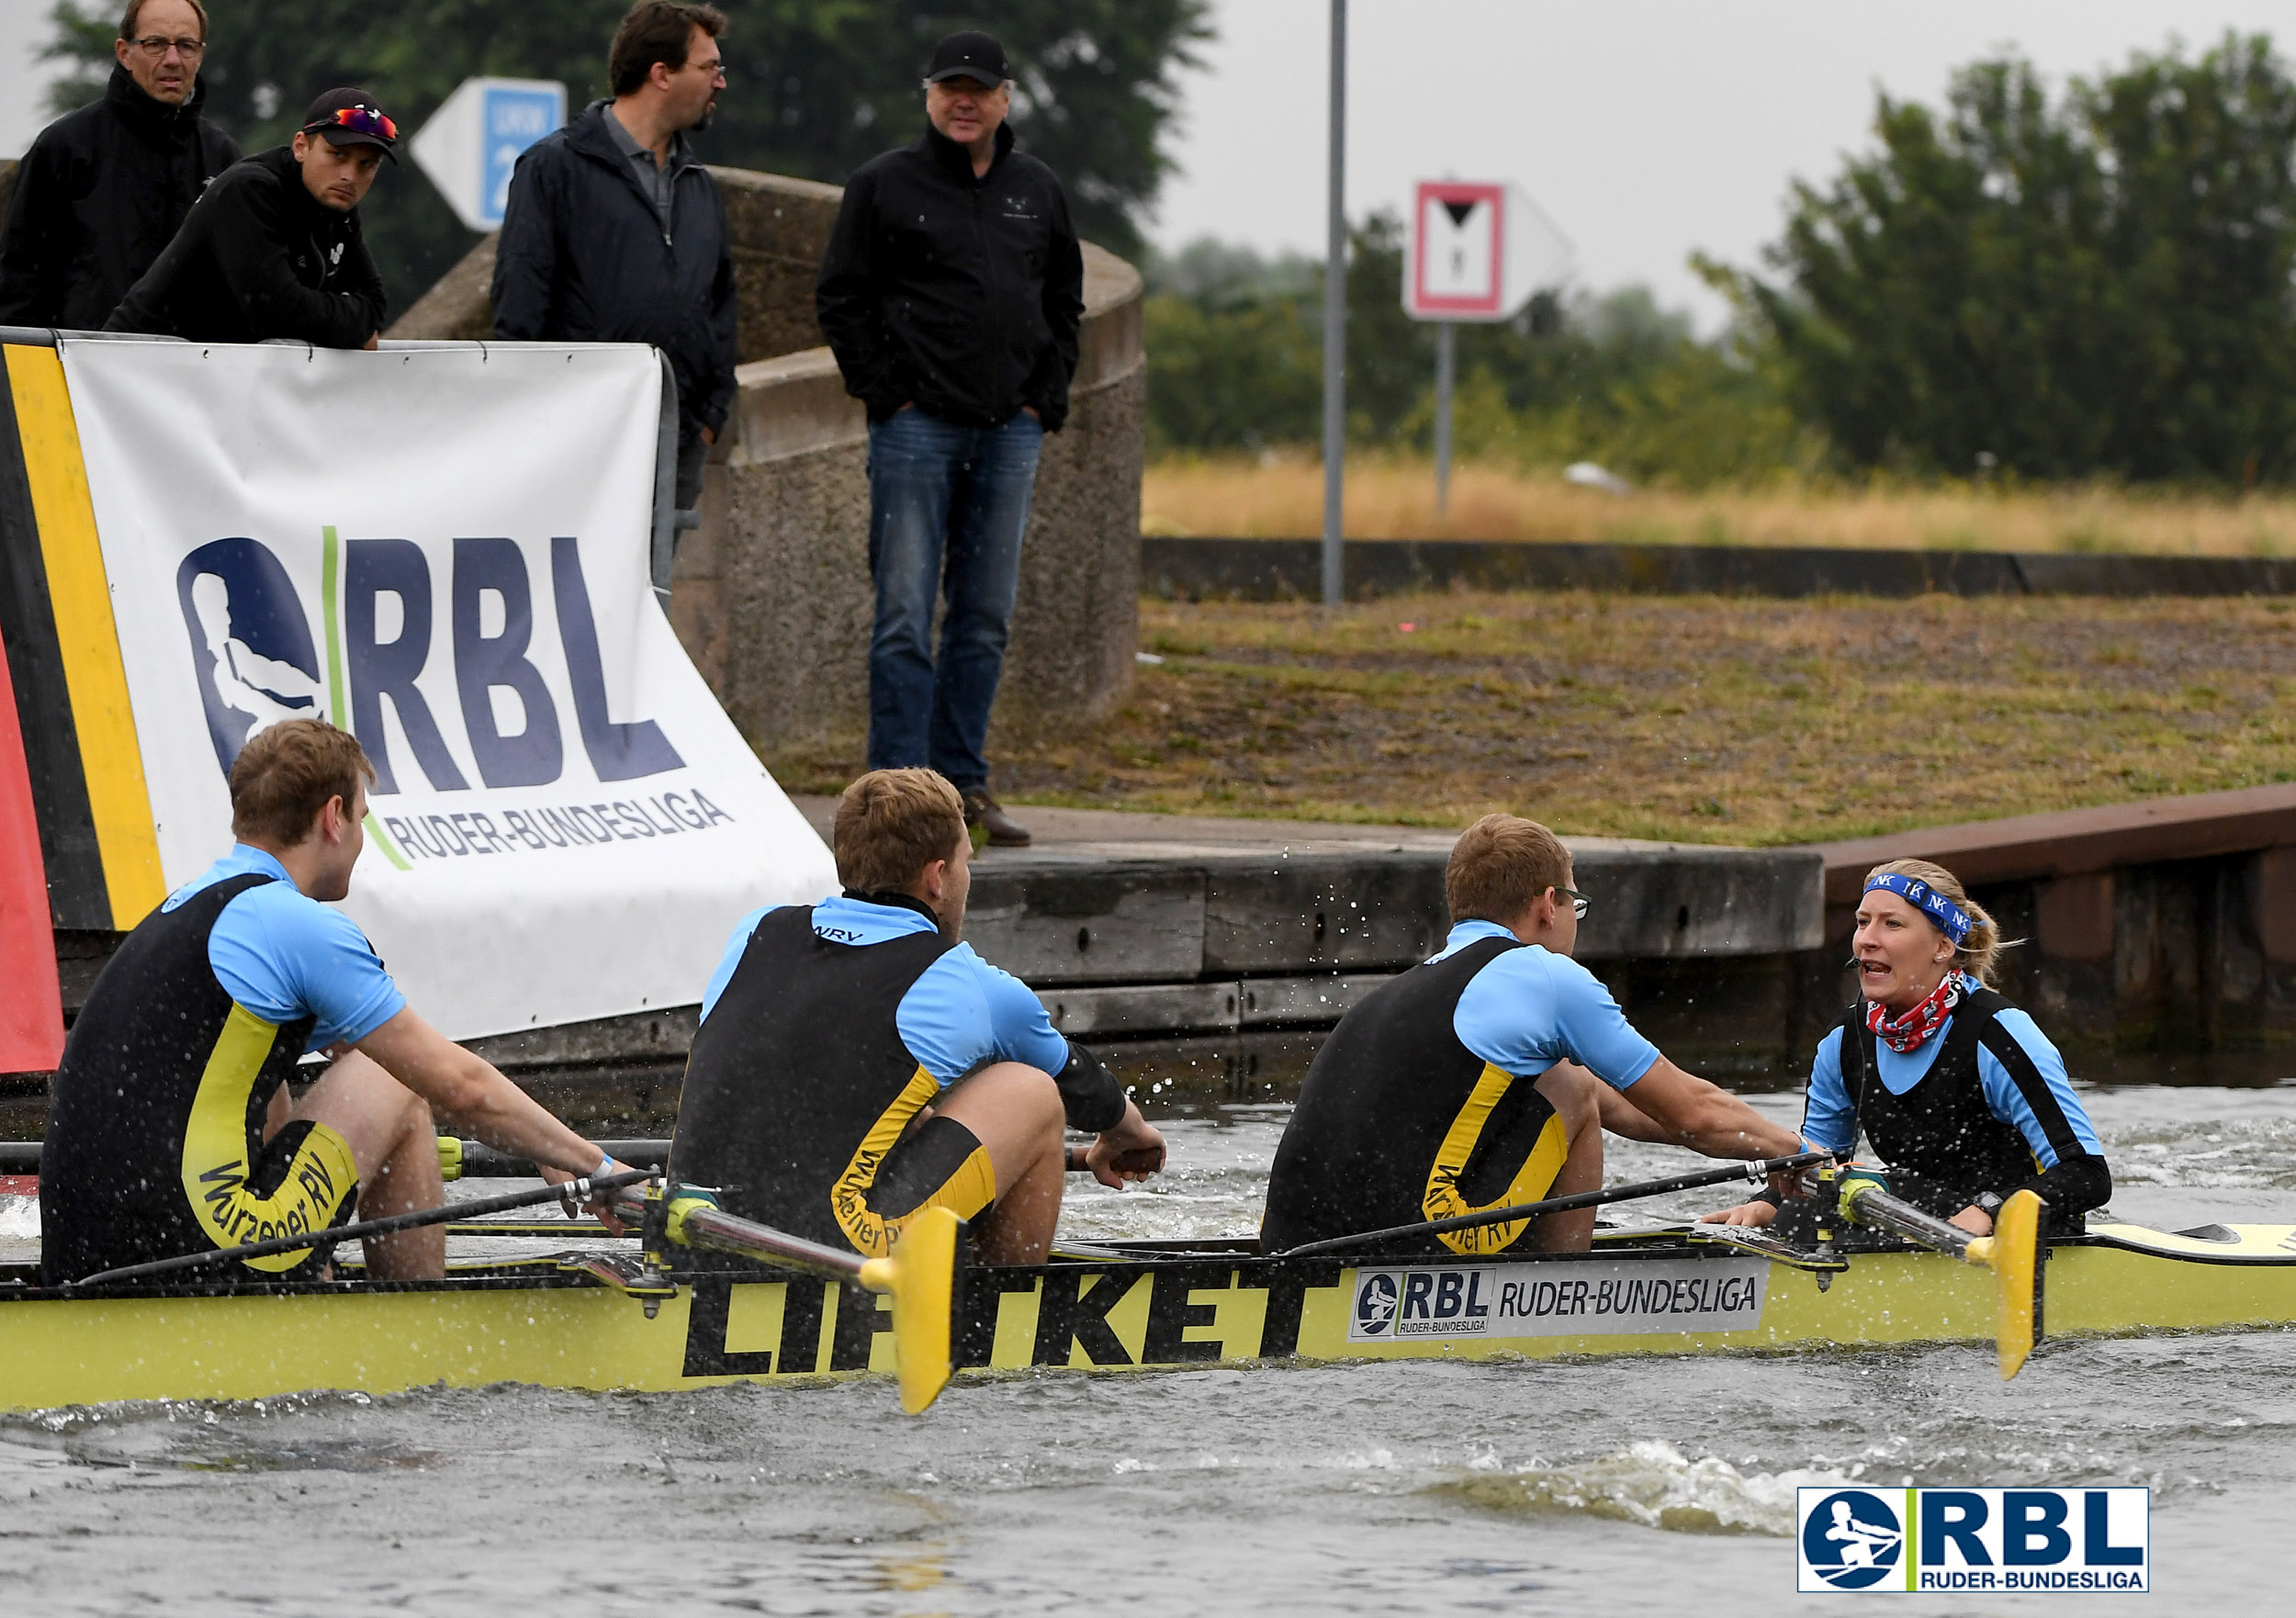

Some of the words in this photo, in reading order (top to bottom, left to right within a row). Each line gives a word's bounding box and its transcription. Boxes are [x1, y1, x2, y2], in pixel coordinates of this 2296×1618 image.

[344, 536, 687, 795] RBL
[385, 788, 737, 860] RUDER-BUNDESLIGA
[1874, 874, 1896, 886] NK
[1929, 894, 1948, 914] NK
[1952, 910, 1969, 930] NK
[814, 926, 864, 942] NRV
[298, 1151, 334, 1221] RV
[682, 1269, 1341, 1376] LIFTKET
[1401, 1270, 1490, 1320] RBL
[1499, 1275, 1756, 1318] RUDER-BUNDESLIGA
[1400, 1320, 1486, 1334] RUDER-BUNDESLIGA
